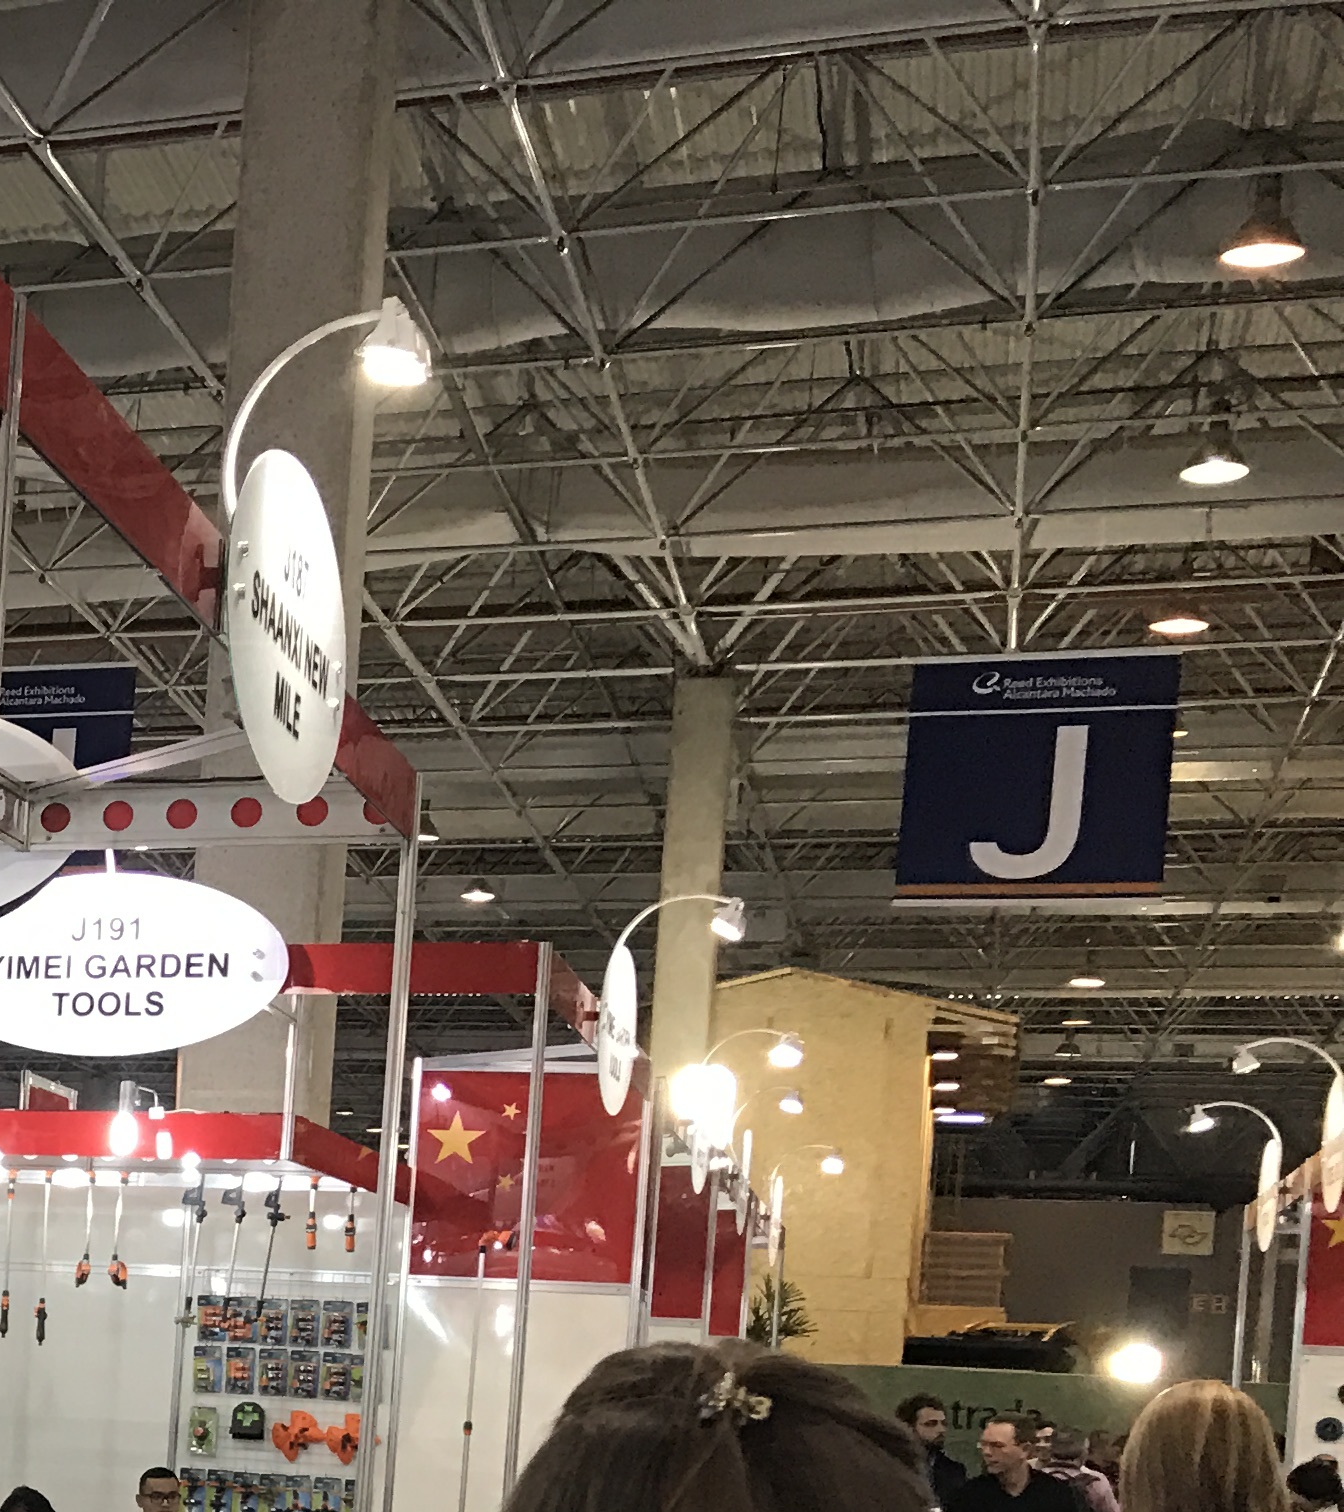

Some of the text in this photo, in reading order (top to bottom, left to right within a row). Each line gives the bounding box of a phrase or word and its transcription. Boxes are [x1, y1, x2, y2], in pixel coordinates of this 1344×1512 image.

[252, 570, 330, 700] SHAANXI NEW
[24, 685, 75, 695] Exhibitions
[1036, 676, 1104, 688] Exhibitions
[1062, 687, 1117, 698] Machado
[44, 693, 86, 704] Machado
[273, 671, 301, 740] MILE
[969, 725, 1089, 879] J
[72, 917, 141, 942] J191
[84, 953, 229, 979] GARDEN
[52, 991, 165, 1017] TOOLS
